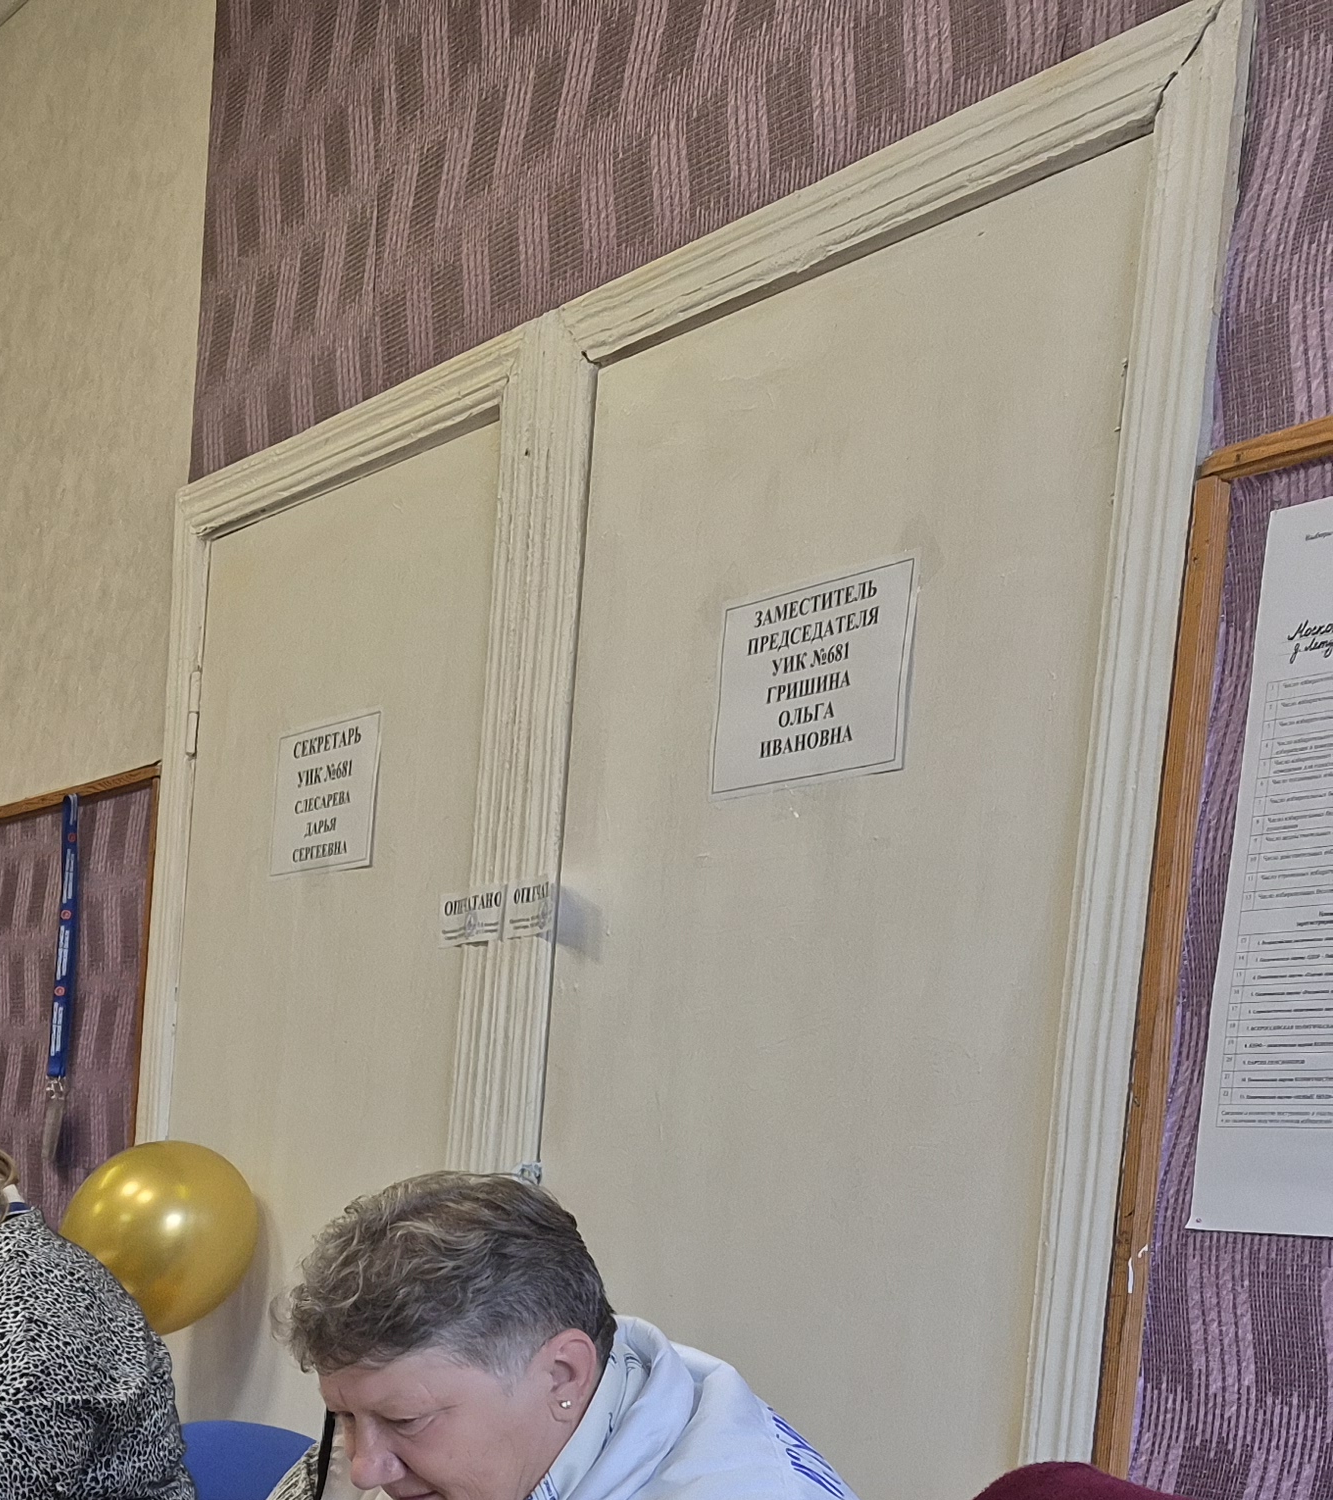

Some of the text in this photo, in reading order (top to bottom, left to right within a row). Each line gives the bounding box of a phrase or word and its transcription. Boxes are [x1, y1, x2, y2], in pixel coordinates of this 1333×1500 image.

[754, 579, 878, 628] ЗАМЕСТИТЕЛЬ
[747, 605, 880, 656] ПРЕДСЕДАТЕЛЯ
[771, 641, 850, 677] УИК №681
[766, 669, 851, 704] ГРИШИНА
[778, 700, 834, 728] ОЛЬГА
[293, 726, 362, 759] СЕКРЕТАРЬ
[759, 724, 853, 759] ИВАНОВНА
[297, 759, 353, 788] УИК №681
[294, 790, 351, 815] СЛЕСАРЕВА
[303, 817, 337, 838] ДАРЬЯ
[292, 840, 347, 863] СЕРГЕЕВНА
